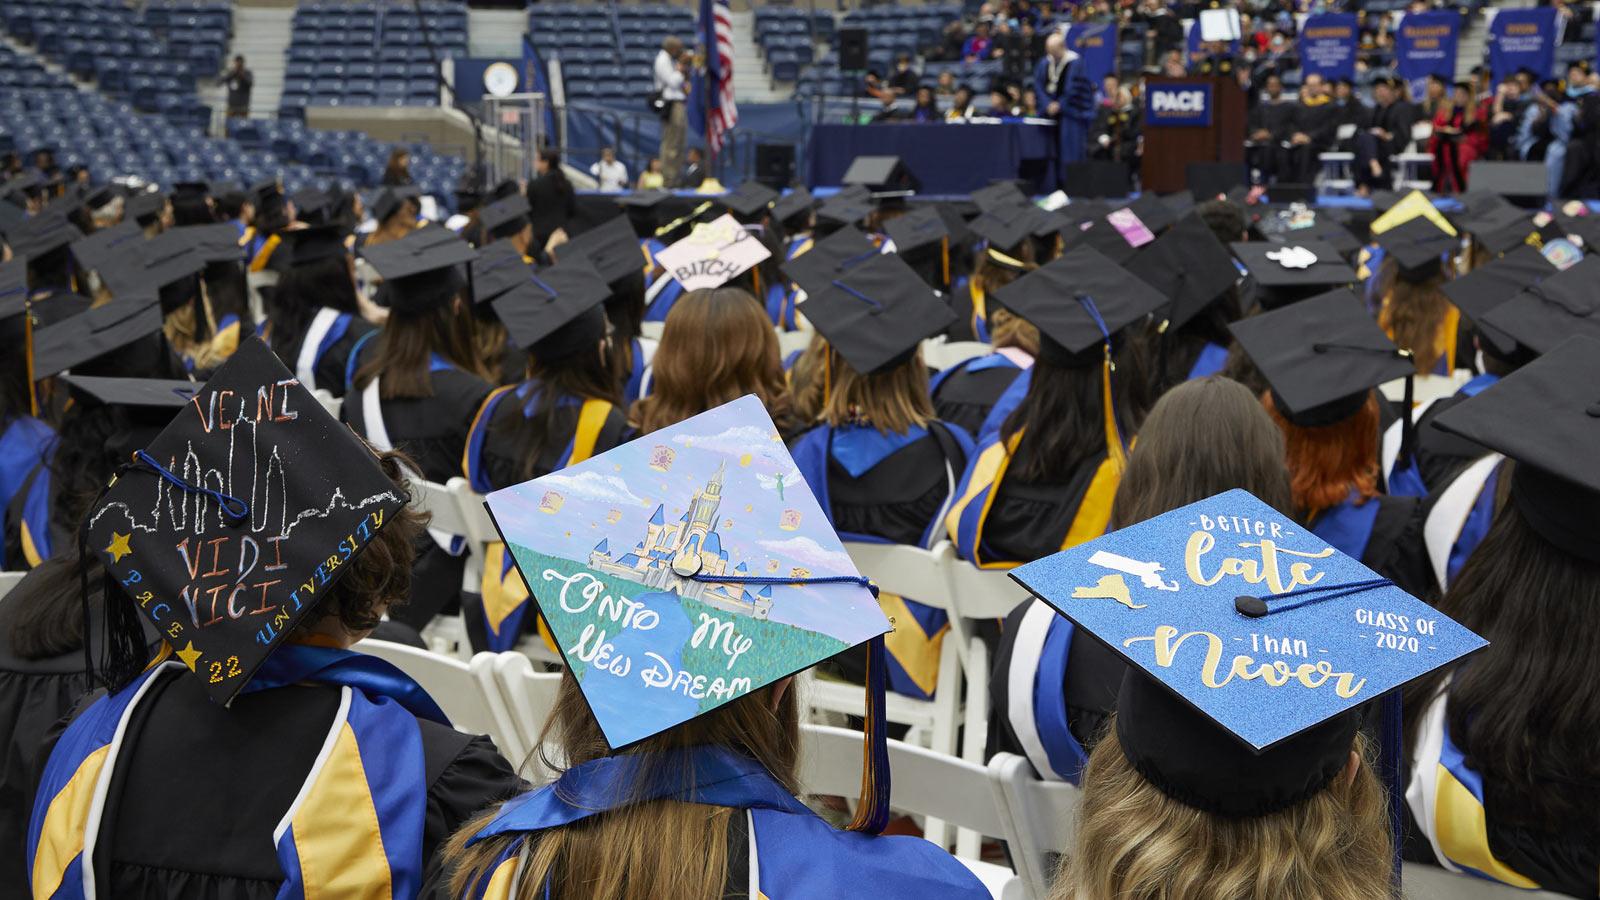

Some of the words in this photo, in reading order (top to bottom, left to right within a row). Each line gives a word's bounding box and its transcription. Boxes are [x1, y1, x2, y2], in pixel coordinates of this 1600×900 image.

[1152, 90, 1205, 111] PACE
[676, 259, 741, 281] BITCH
[191, 378, 299, 433] VENI
[176, 534, 289, 584] VIDI
[256, 508, 384, 646] UNIVERSITY
[122, 569, 184, 638] PACE
[179, 579, 282, 628] VICI
[1356, 608, 1410, 632] CLASS
[1416, 618, 1437, 636] OF
[1376, 631, 1419, 653] 2020
[641, 651, 751, 700] DREAM
